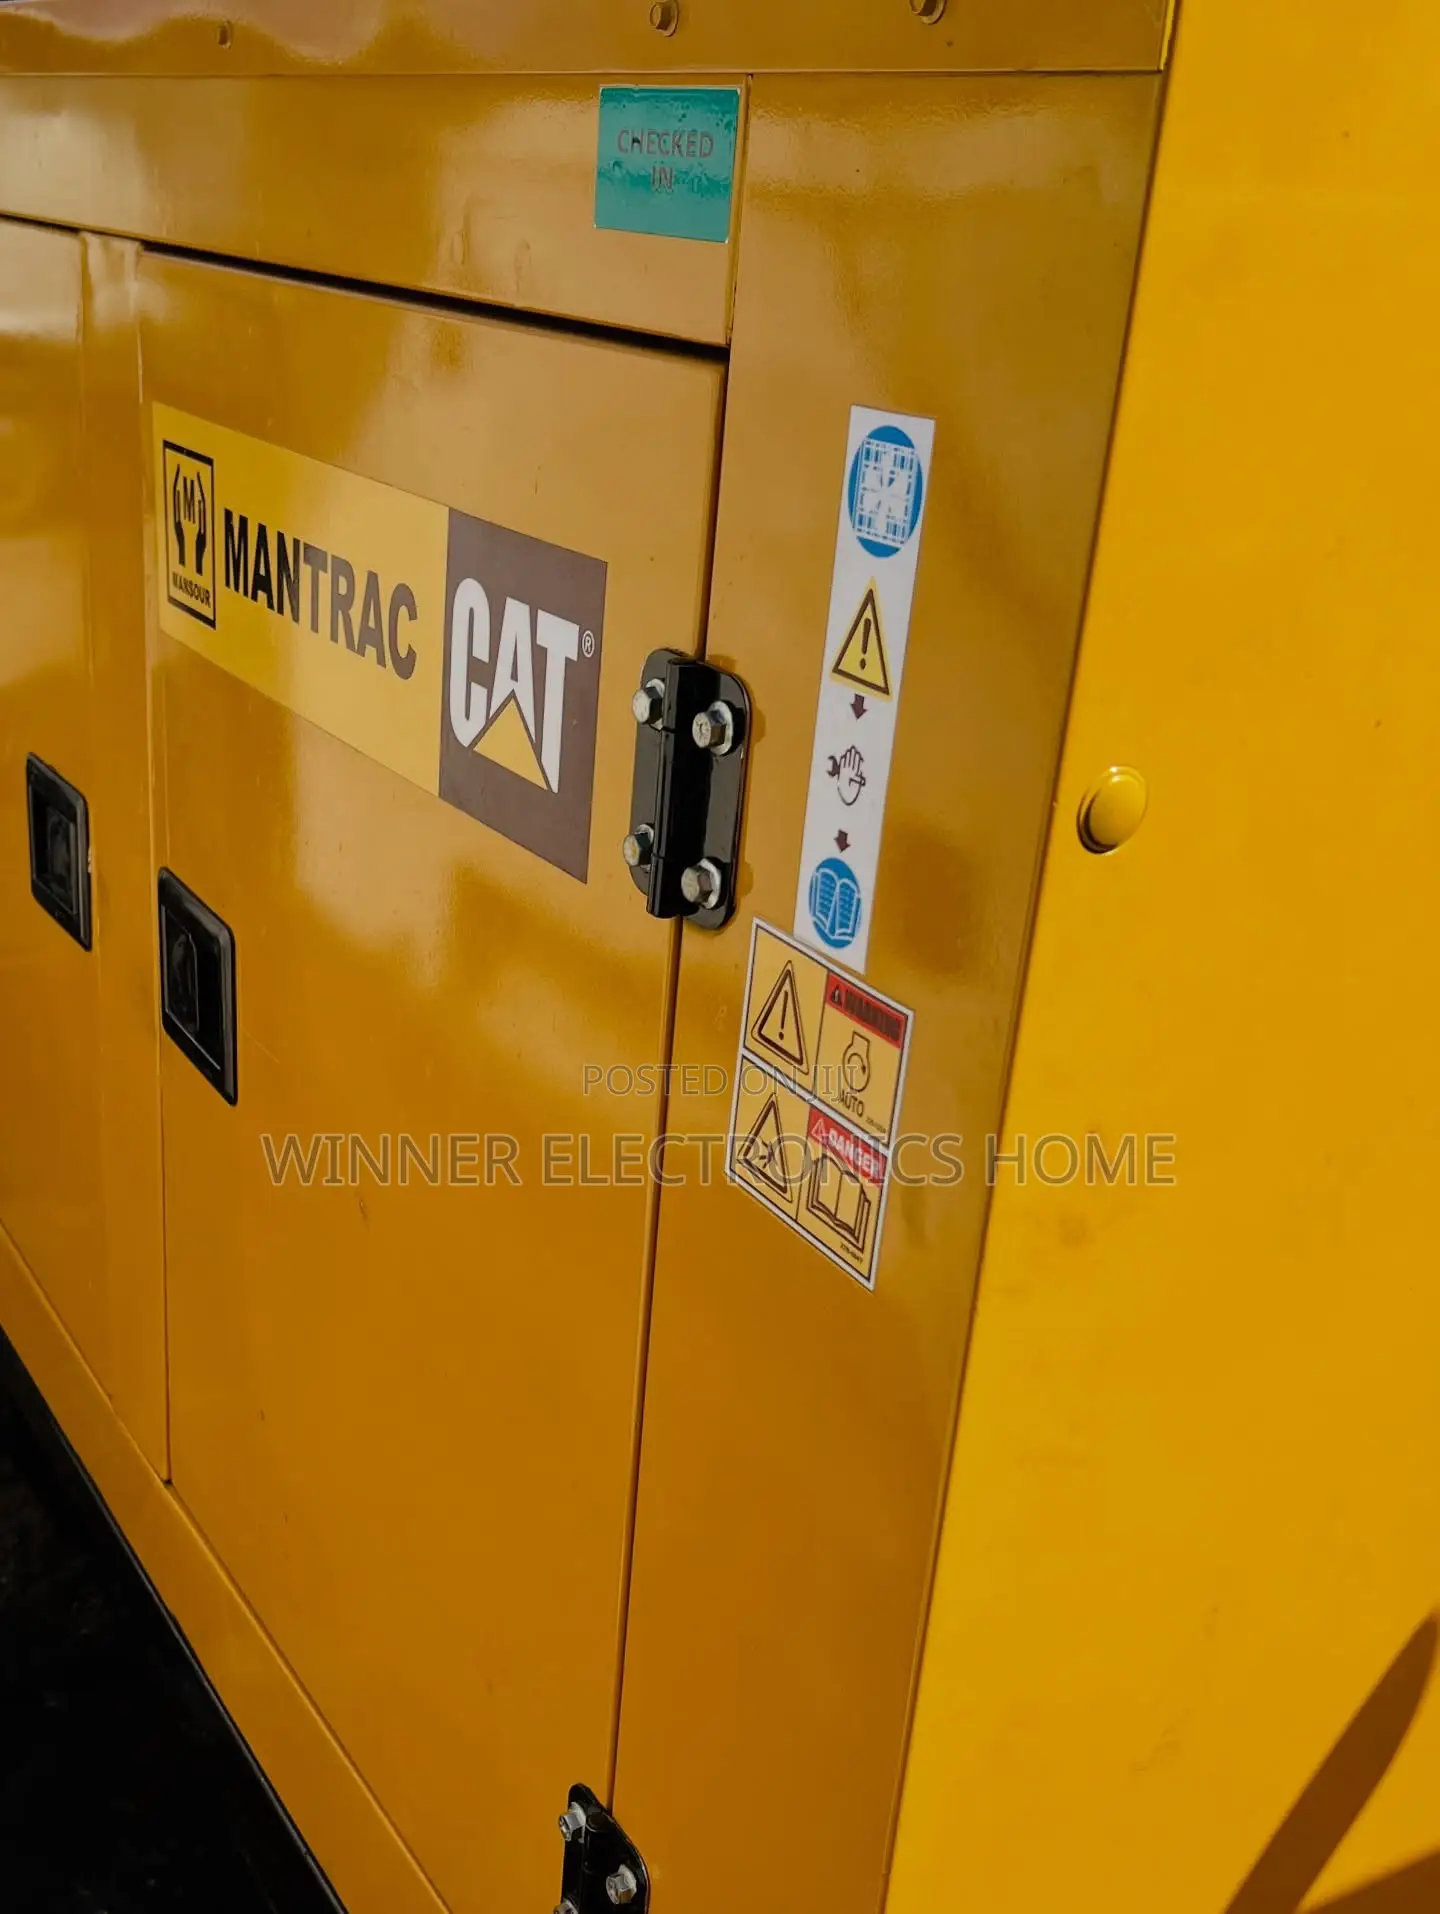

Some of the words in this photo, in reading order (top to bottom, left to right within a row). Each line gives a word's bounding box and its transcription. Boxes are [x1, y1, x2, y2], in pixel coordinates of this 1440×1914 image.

[617, 128, 714, 158] CHECKED
[651, 165, 674, 190] IN
[172, 571, 212, 609] MANSOUR
[223, 507, 418, 681] MANTRAC
[449, 577, 580, 794] CAT
[839, 1088, 865, 1117] AUTO
[828, 1127, 884, 1181] DANGER
